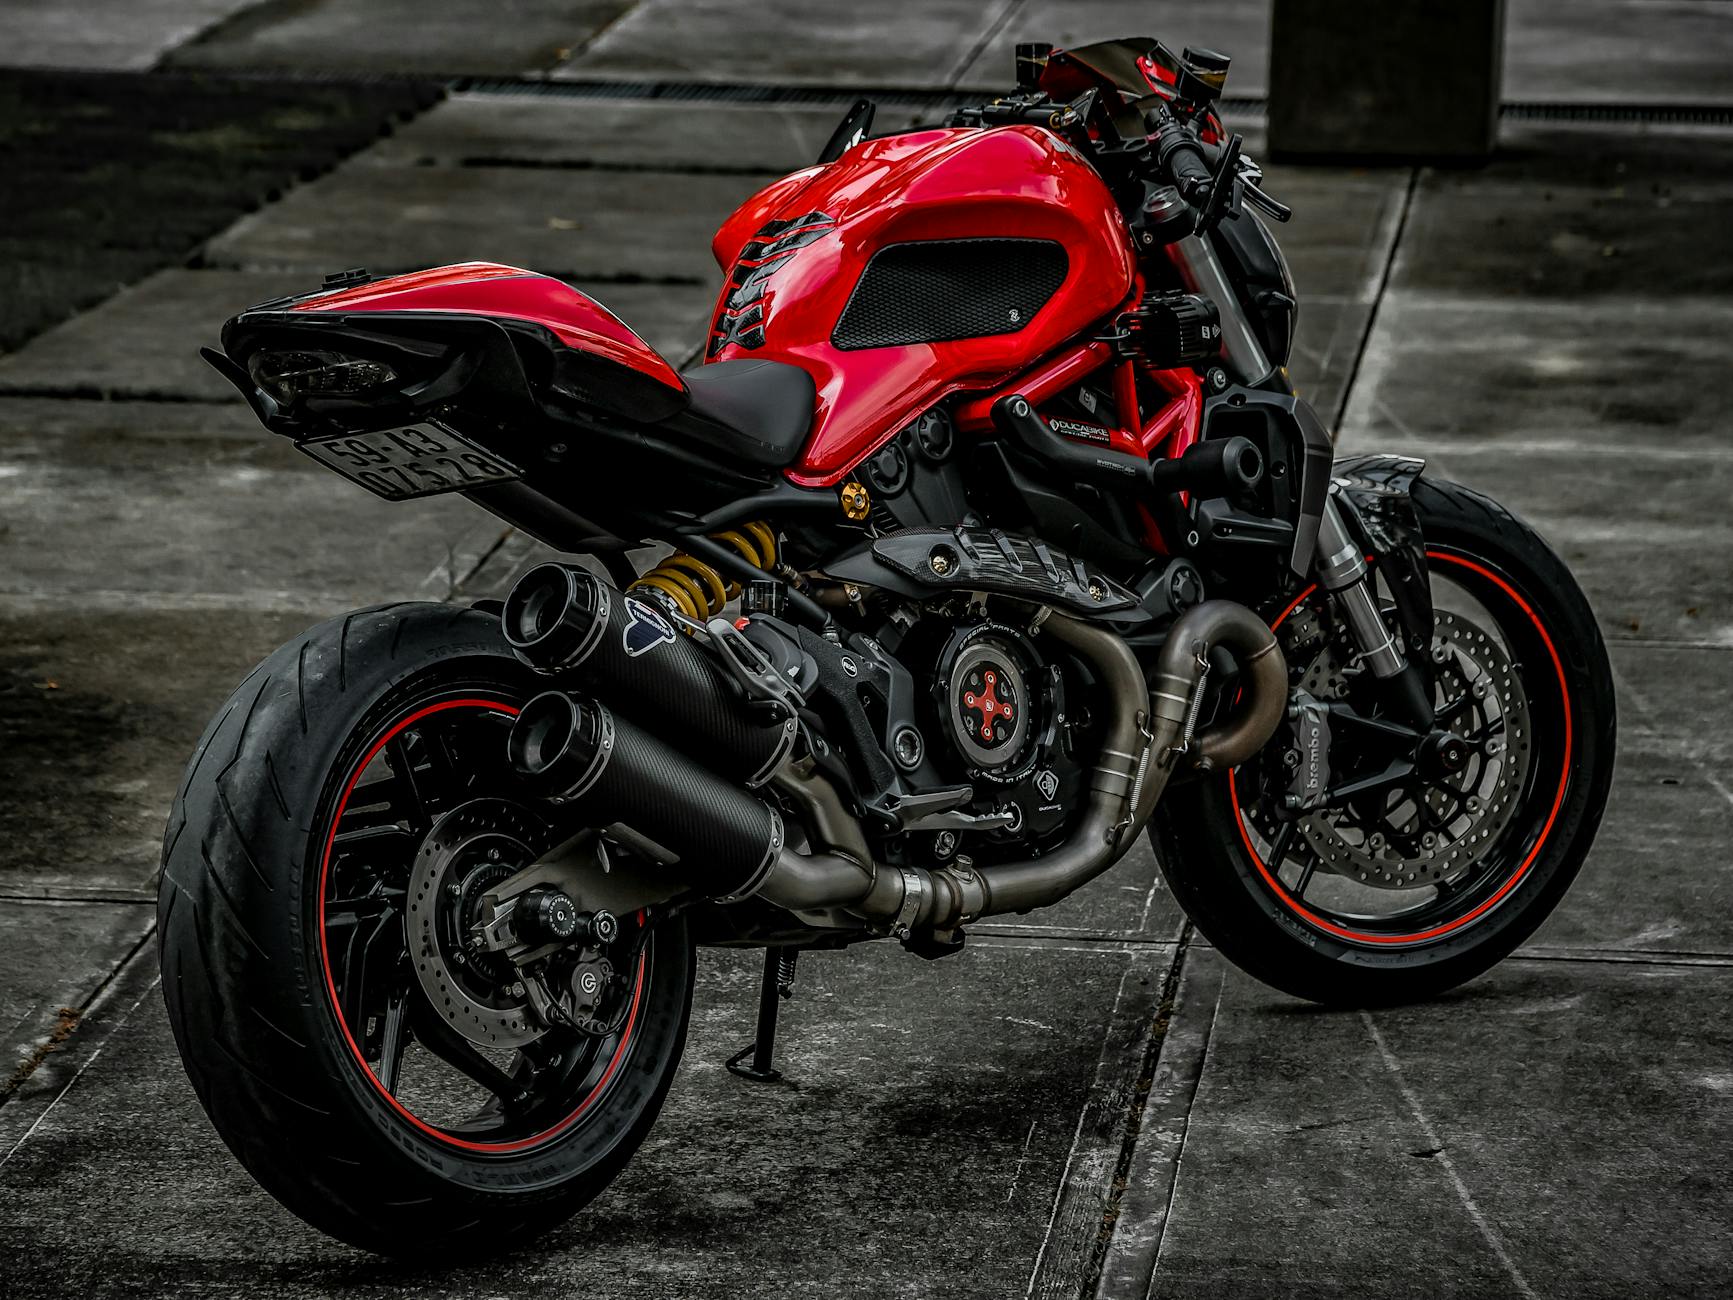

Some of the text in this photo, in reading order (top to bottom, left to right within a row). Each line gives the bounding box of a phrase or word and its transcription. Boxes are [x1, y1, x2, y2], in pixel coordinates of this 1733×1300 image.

[1059, 420, 1109, 437] DUCABIKE
[321, 428, 448, 467] 59-A3
[1306, 727, 1320, 789] brembo
[981, 771, 1004, 784] MADE
[1016, 763, 1037, 782] ITALY
